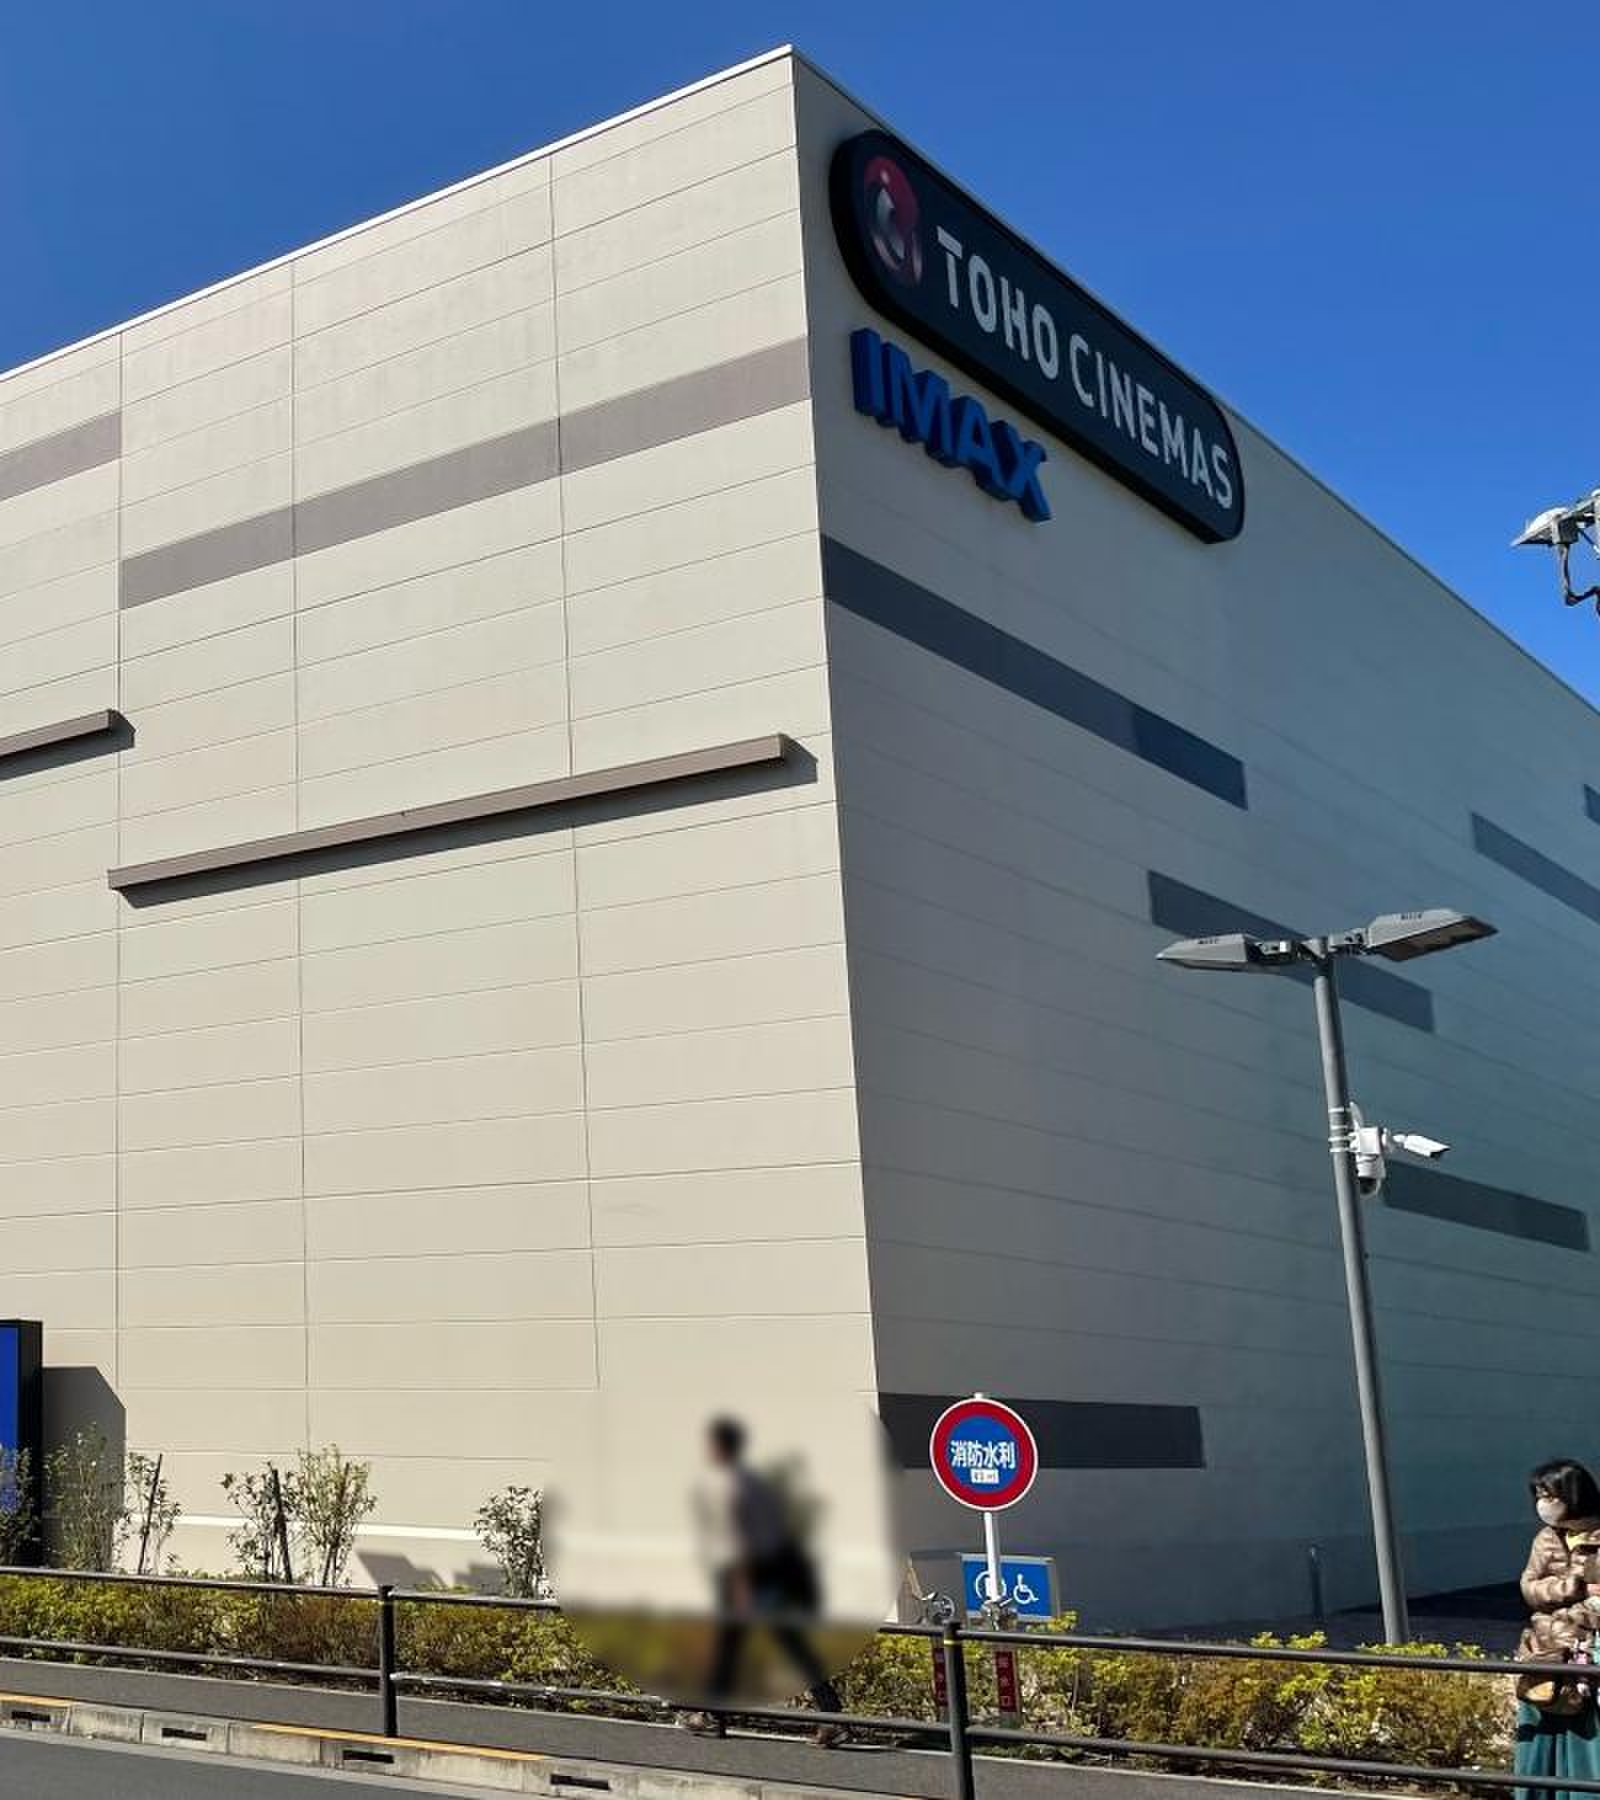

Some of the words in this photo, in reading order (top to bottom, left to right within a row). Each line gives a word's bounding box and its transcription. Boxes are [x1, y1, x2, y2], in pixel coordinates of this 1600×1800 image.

[851, 327, 1053, 525] IMAX
[936, 225, 1060, 381] TOHO
[1069, 332, 1234, 510] CINEMAS
[950, 1439, 1017, 1470] 消防水利
